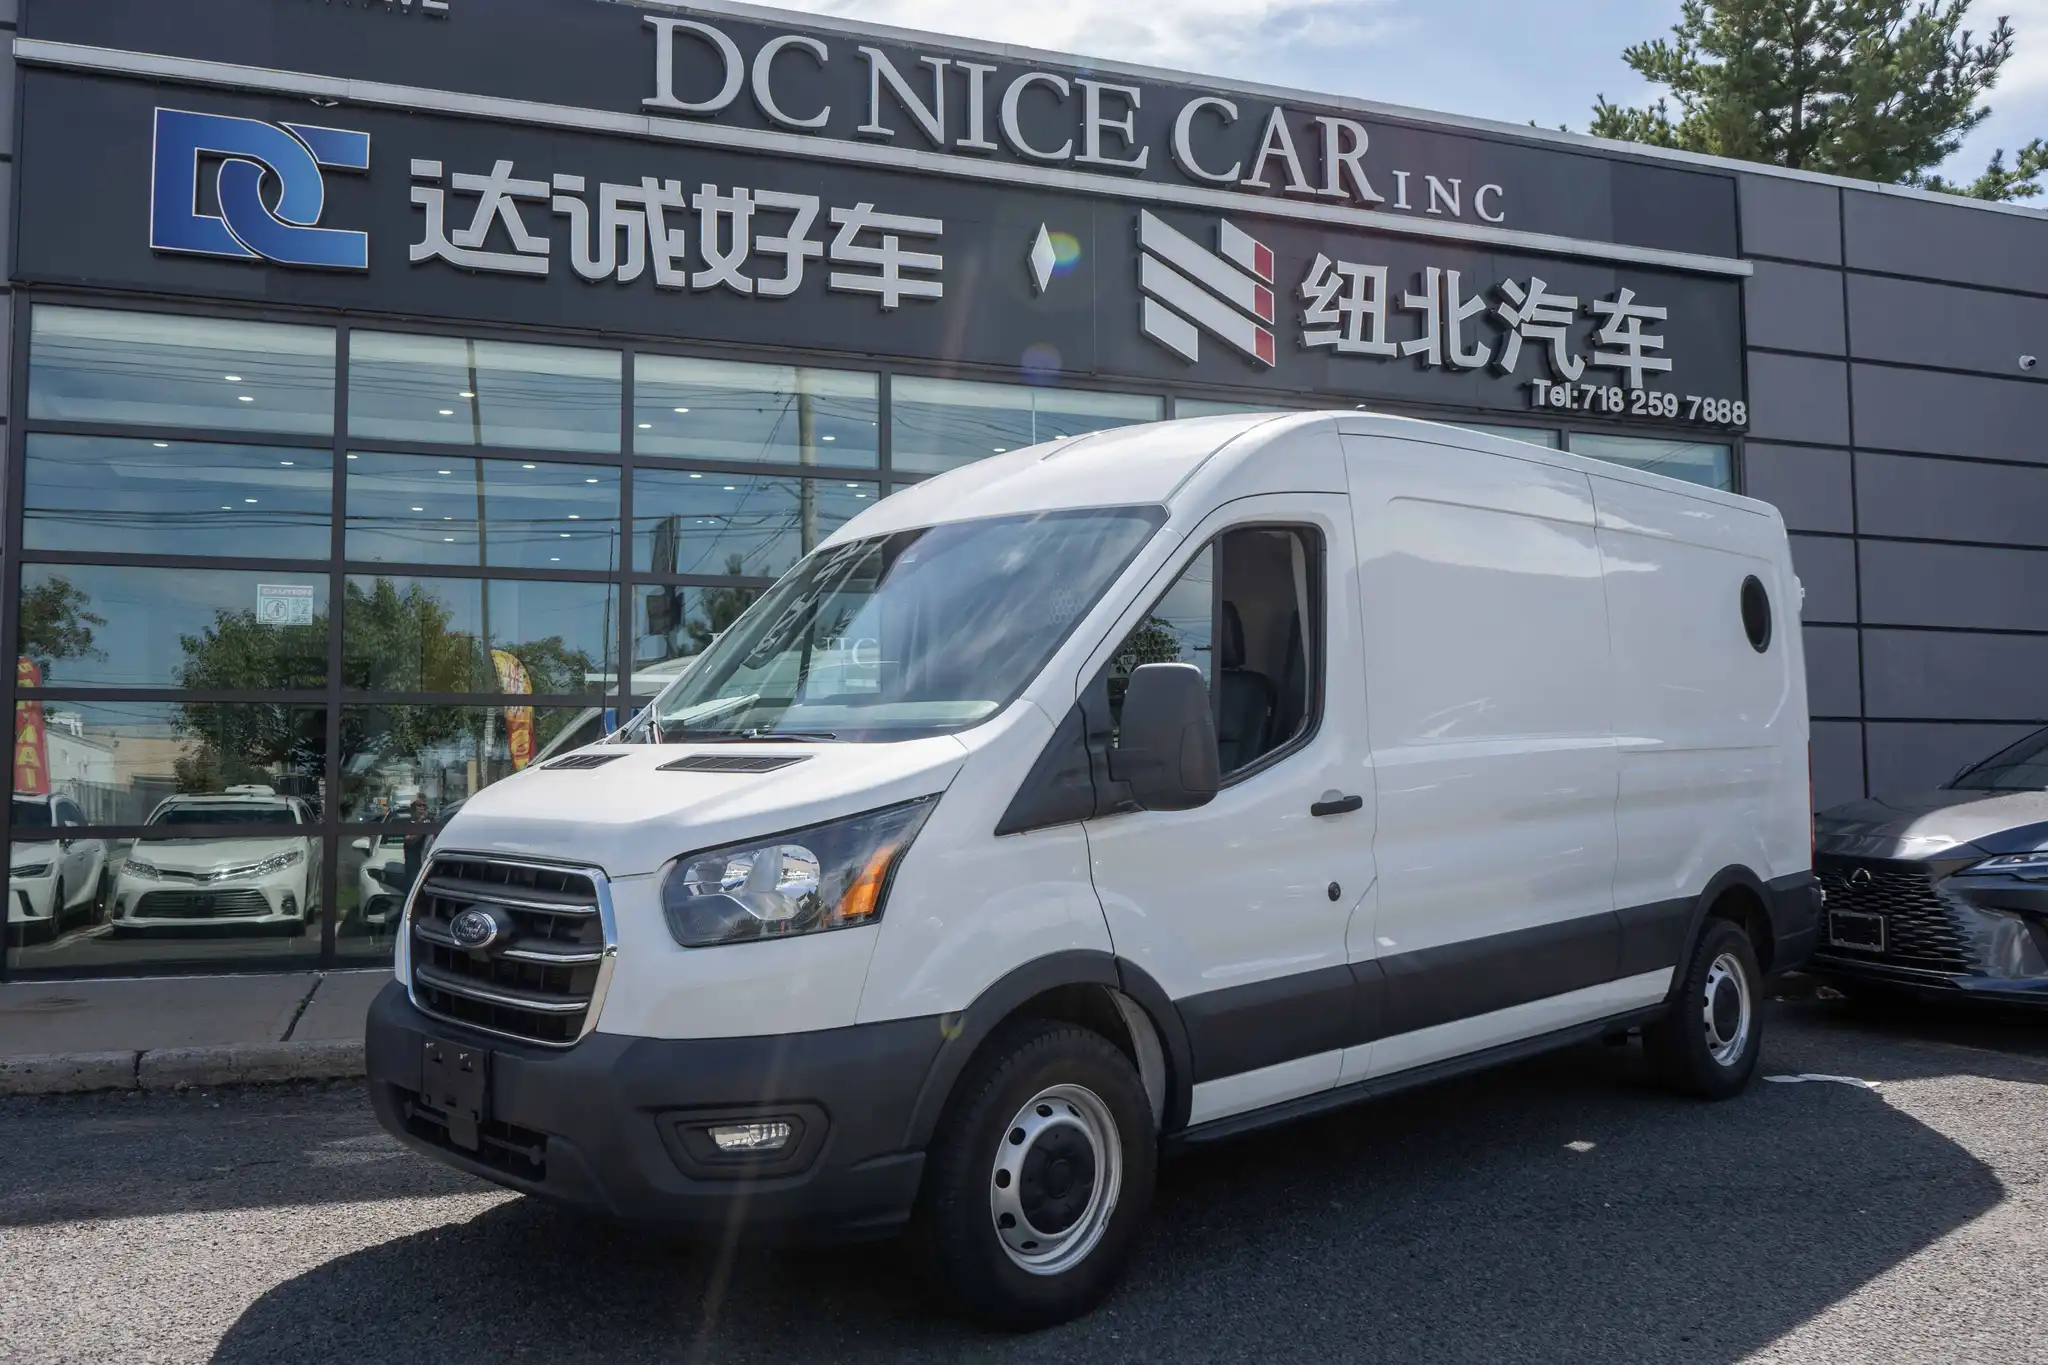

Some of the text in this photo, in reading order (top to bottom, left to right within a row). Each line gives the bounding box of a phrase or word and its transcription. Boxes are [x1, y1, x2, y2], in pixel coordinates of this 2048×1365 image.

[642, 14, 1506, 223] DC NICE CAR INC
[409, 159, 944, 309] 达诚好车
[1300, 252, 1673, 389] 纽北汽车
[1631, 390, 1679, 419] 259
[1685, 394, 1748, 426] 7888
